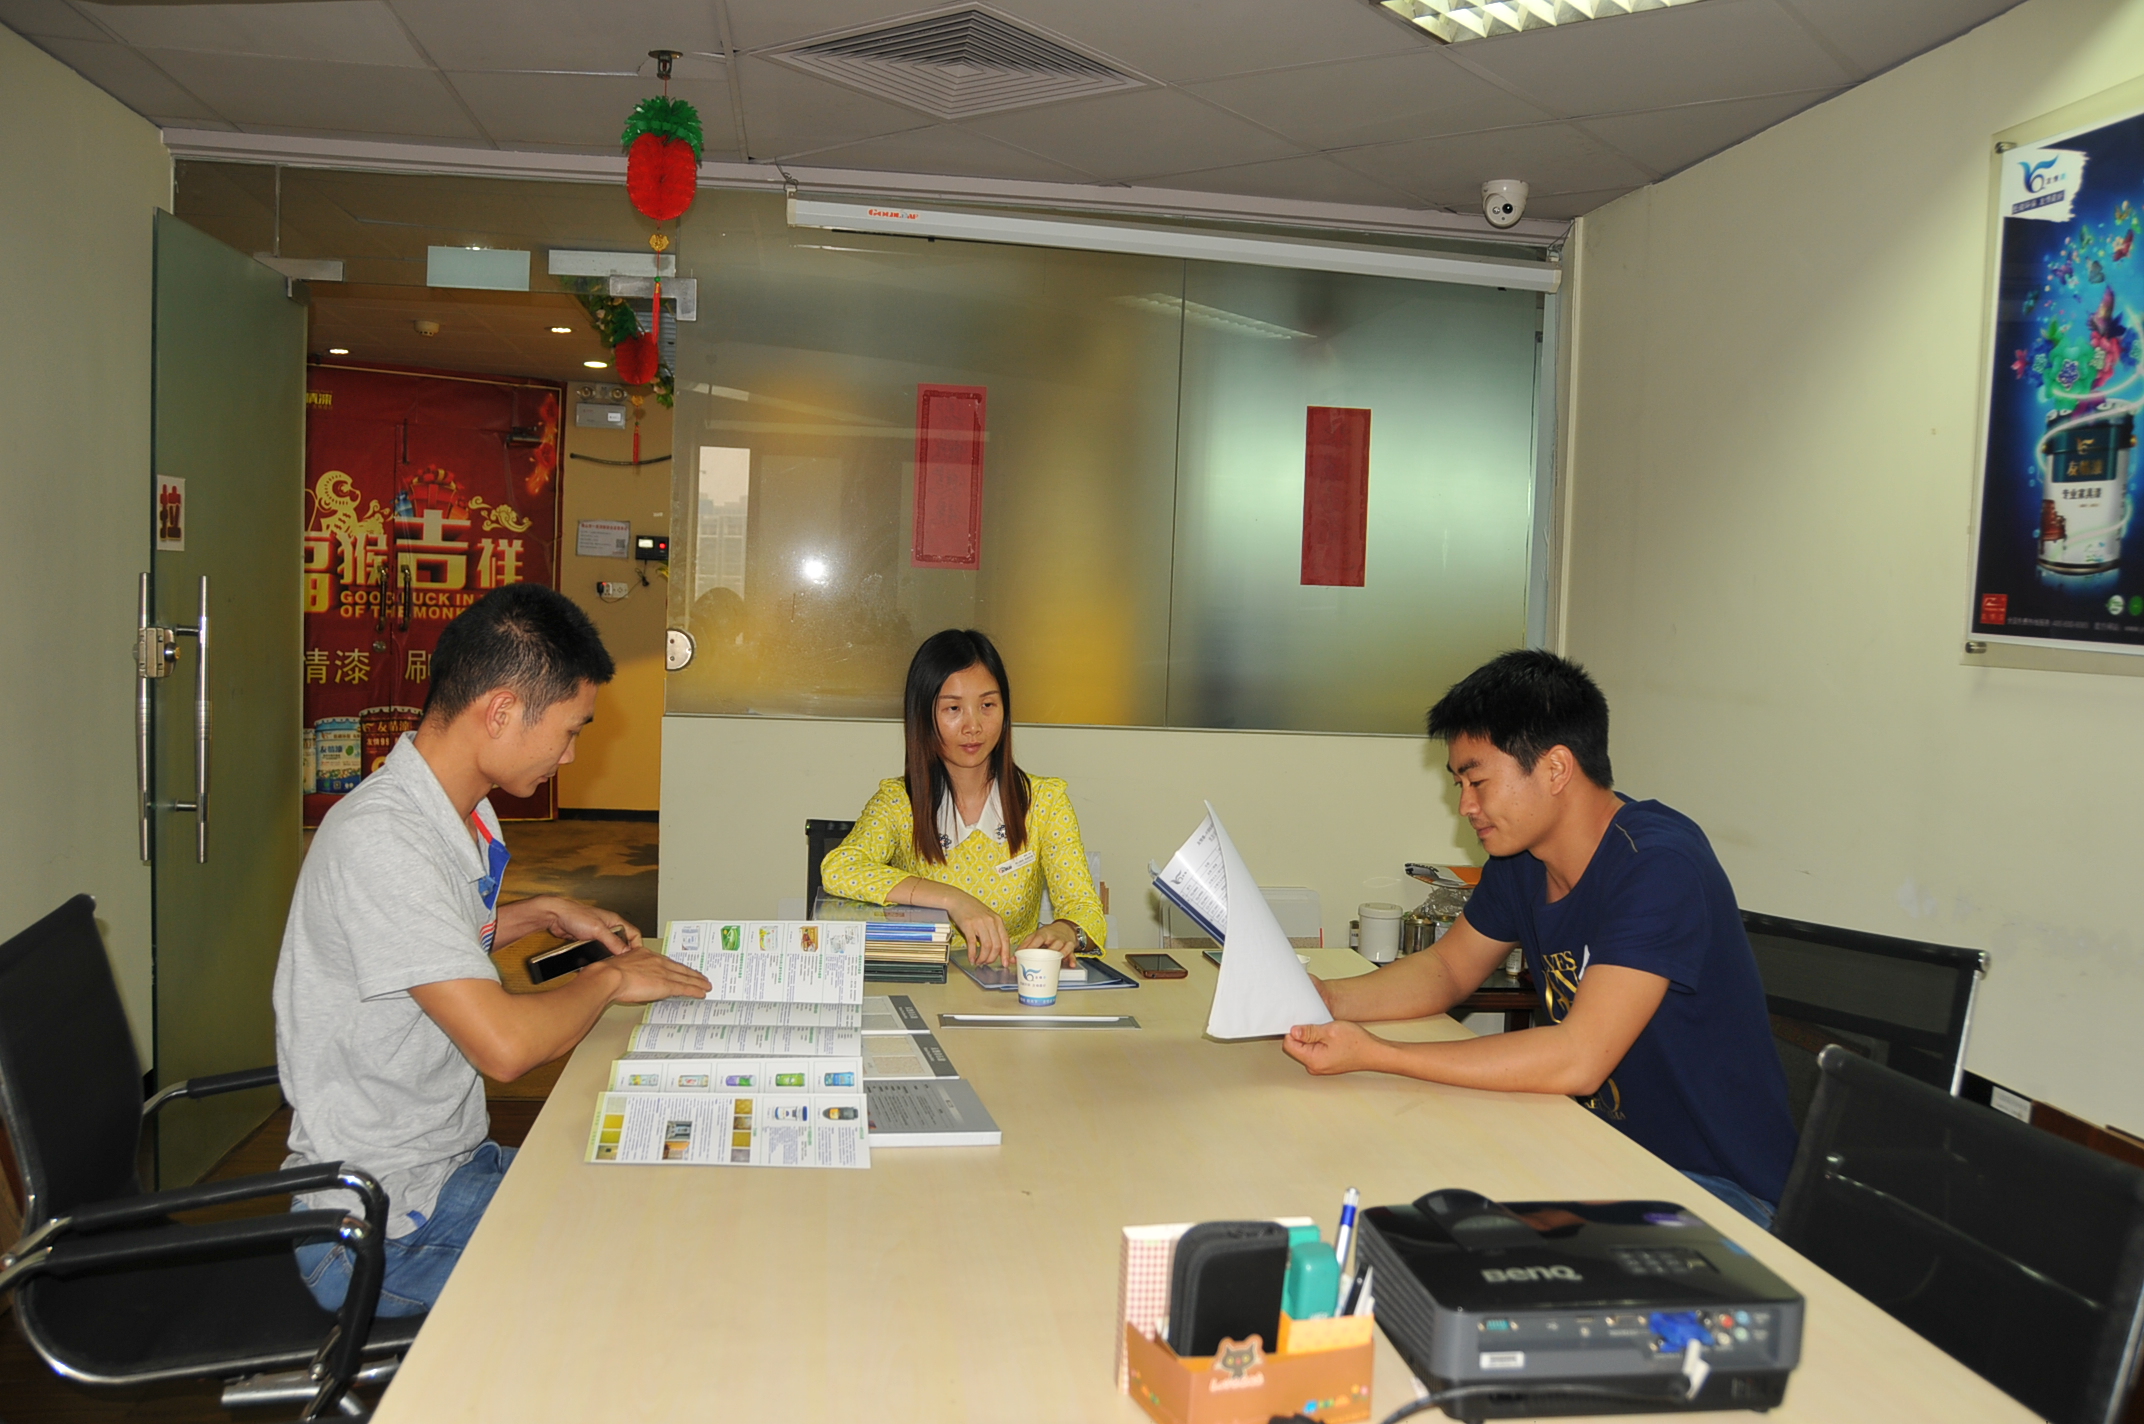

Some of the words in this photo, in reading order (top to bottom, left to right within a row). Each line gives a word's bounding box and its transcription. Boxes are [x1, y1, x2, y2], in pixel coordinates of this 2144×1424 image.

[456, 593, 475, 606] IN
[340, 605, 366, 618] OF
[1480, 1265, 1583, 1283] BenQ
